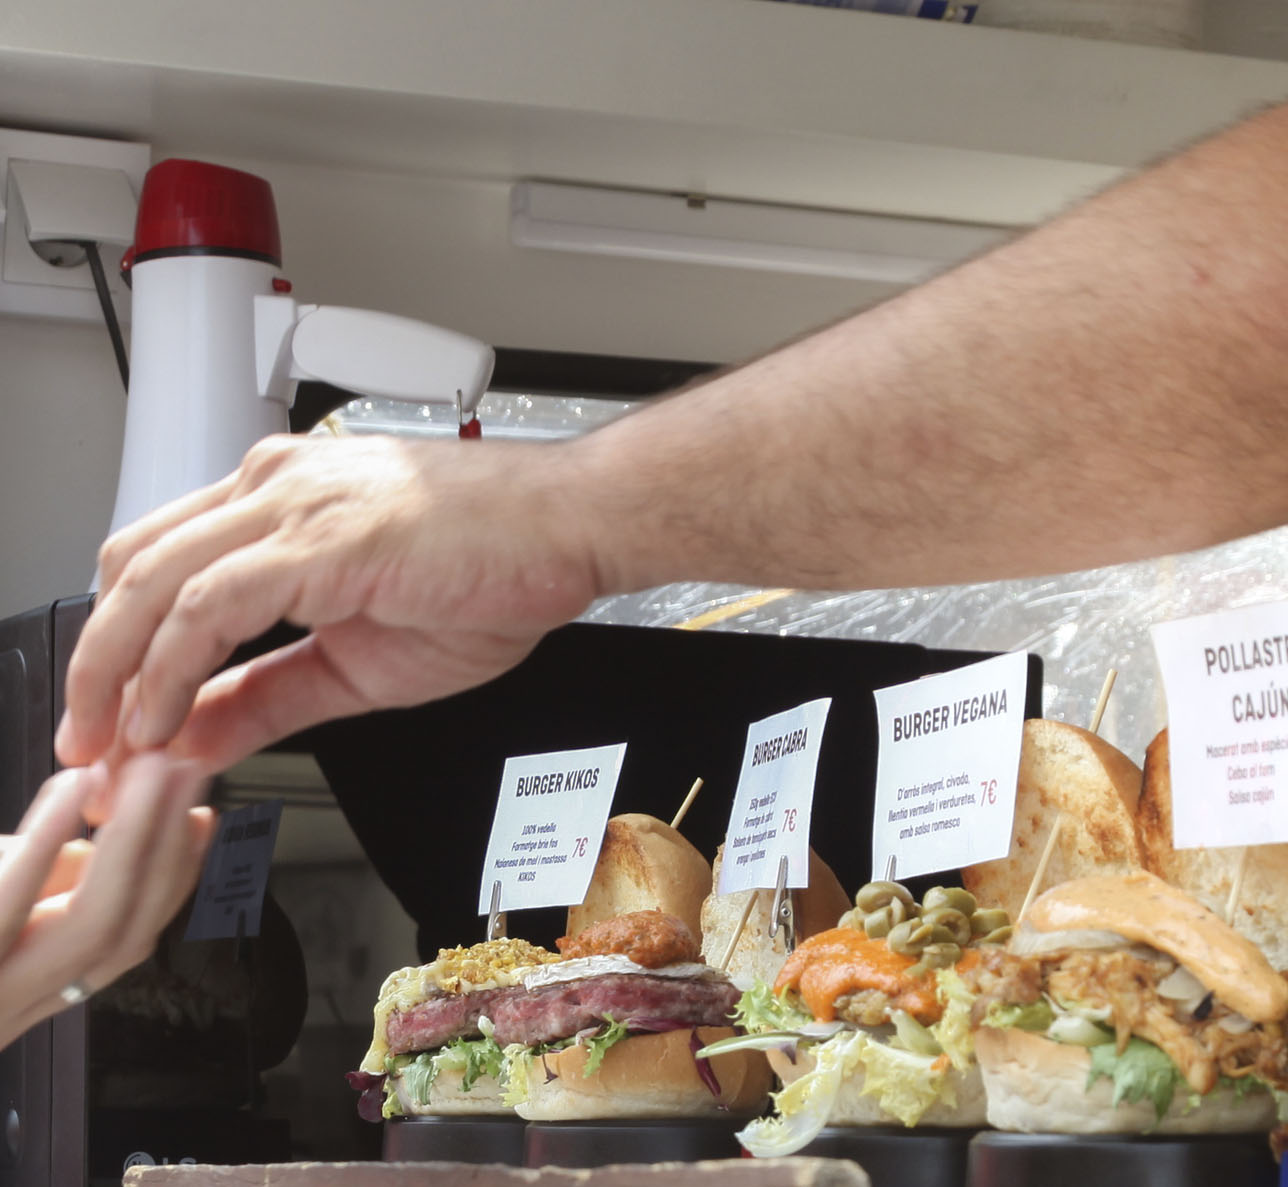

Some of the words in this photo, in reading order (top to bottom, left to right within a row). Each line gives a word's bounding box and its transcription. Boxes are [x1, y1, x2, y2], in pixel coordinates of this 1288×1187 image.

[893, 705, 950, 743] BURGER
[953, 688, 1008, 728] VEGANA
[752, 736, 783, 768] BURGER
[782, 727, 808, 757] CABRA
[1241, 738, 1259, 755] amb
[516, 773, 562, 798] BURGER
[564, 768, 600, 792] KIKOS
[980, 778, 998, 807] 7€
[522, 824, 537, 836] 100%
[537, 823, 557, 834] vedella
[782, 808, 798, 833] 7€
[931, 817, 961, 833] romesco
[511, 841, 537, 852] Formatge
[537, 839, 549, 849] brie
[572, 837, 588, 858] 7€
[519, 856, 526, 866] de
[517, 871, 536, 882] KIKOS
